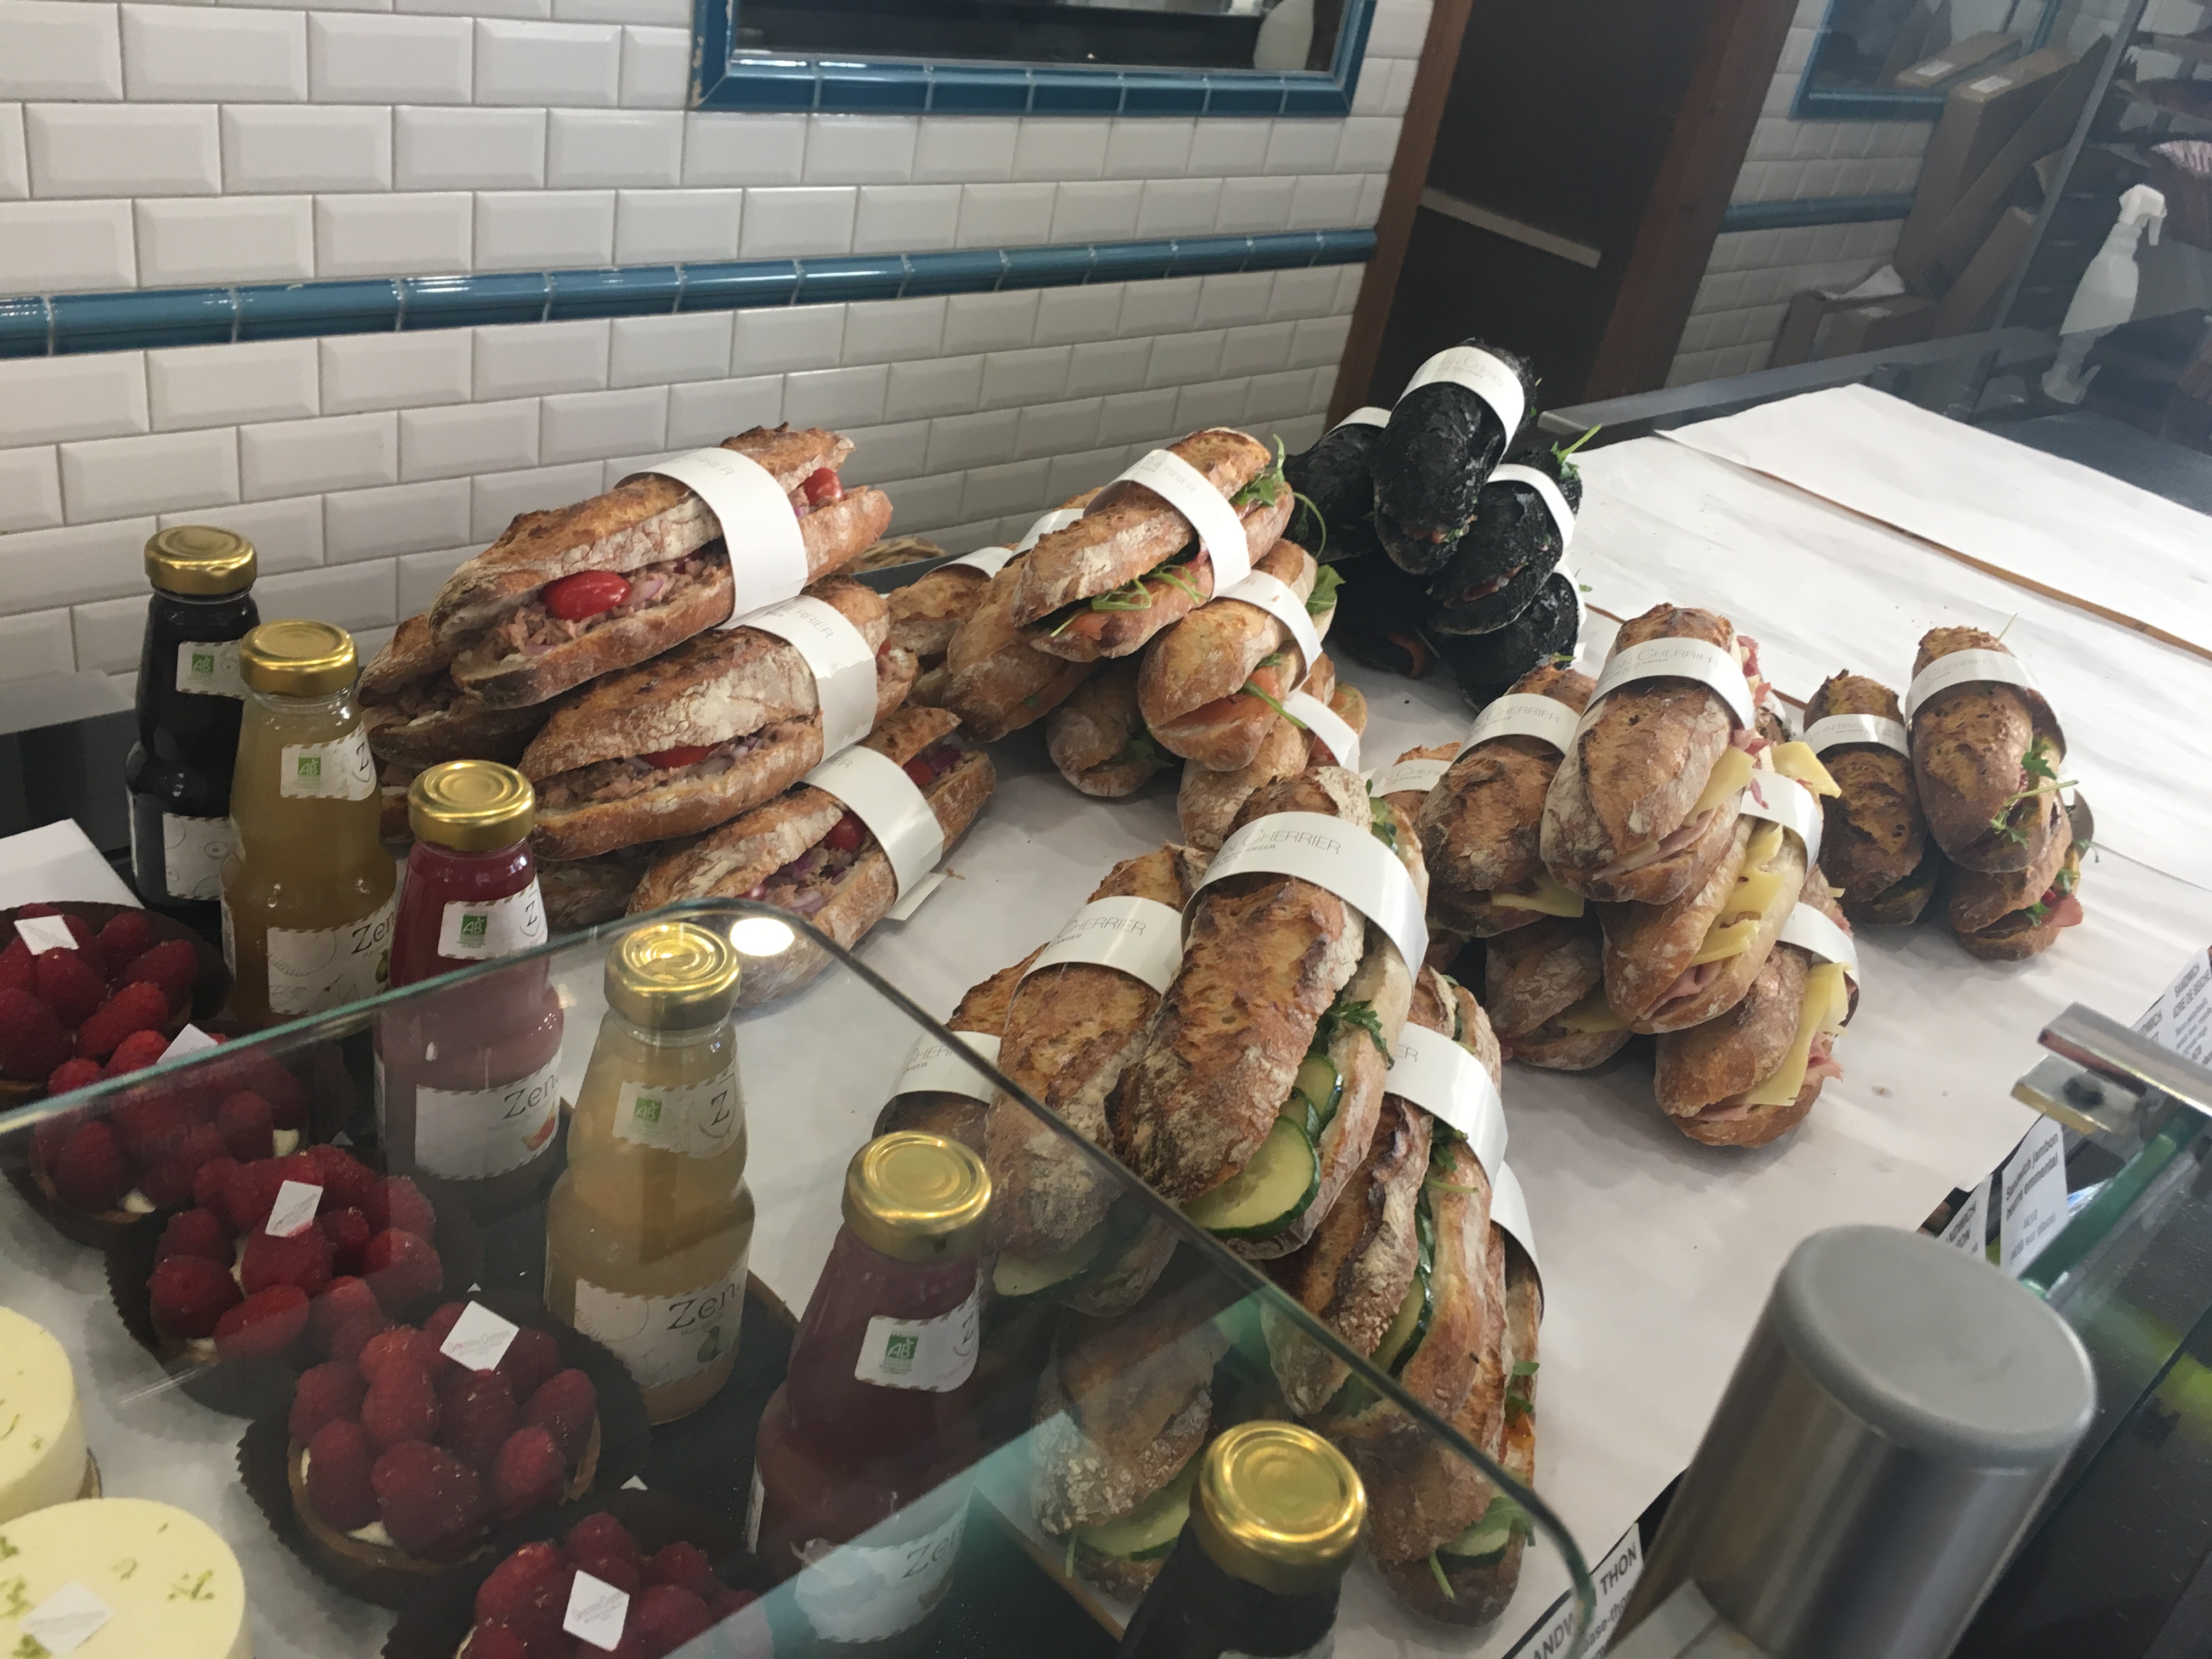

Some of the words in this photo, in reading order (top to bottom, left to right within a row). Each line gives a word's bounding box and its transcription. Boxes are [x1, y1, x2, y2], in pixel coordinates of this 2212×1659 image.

[1638, 649, 1719, 667] CHERRIER
[1486, 706, 1560, 723] CHERRIER
[300, 761, 318, 776] AB
[1243, 829, 1342, 855] CHERRIER
[462, 920, 483, 934] AB
[1057, 917, 1147, 938] CHERRIER
[635, 1105, 657, 1120] AB
[2032, 1132, 2058, 1169] jambon
[2024, 1151, 2058, 1194] emmental
[887, 1342, 911, 1359] AB
[1600, 1542, 1637, 1596] THON
